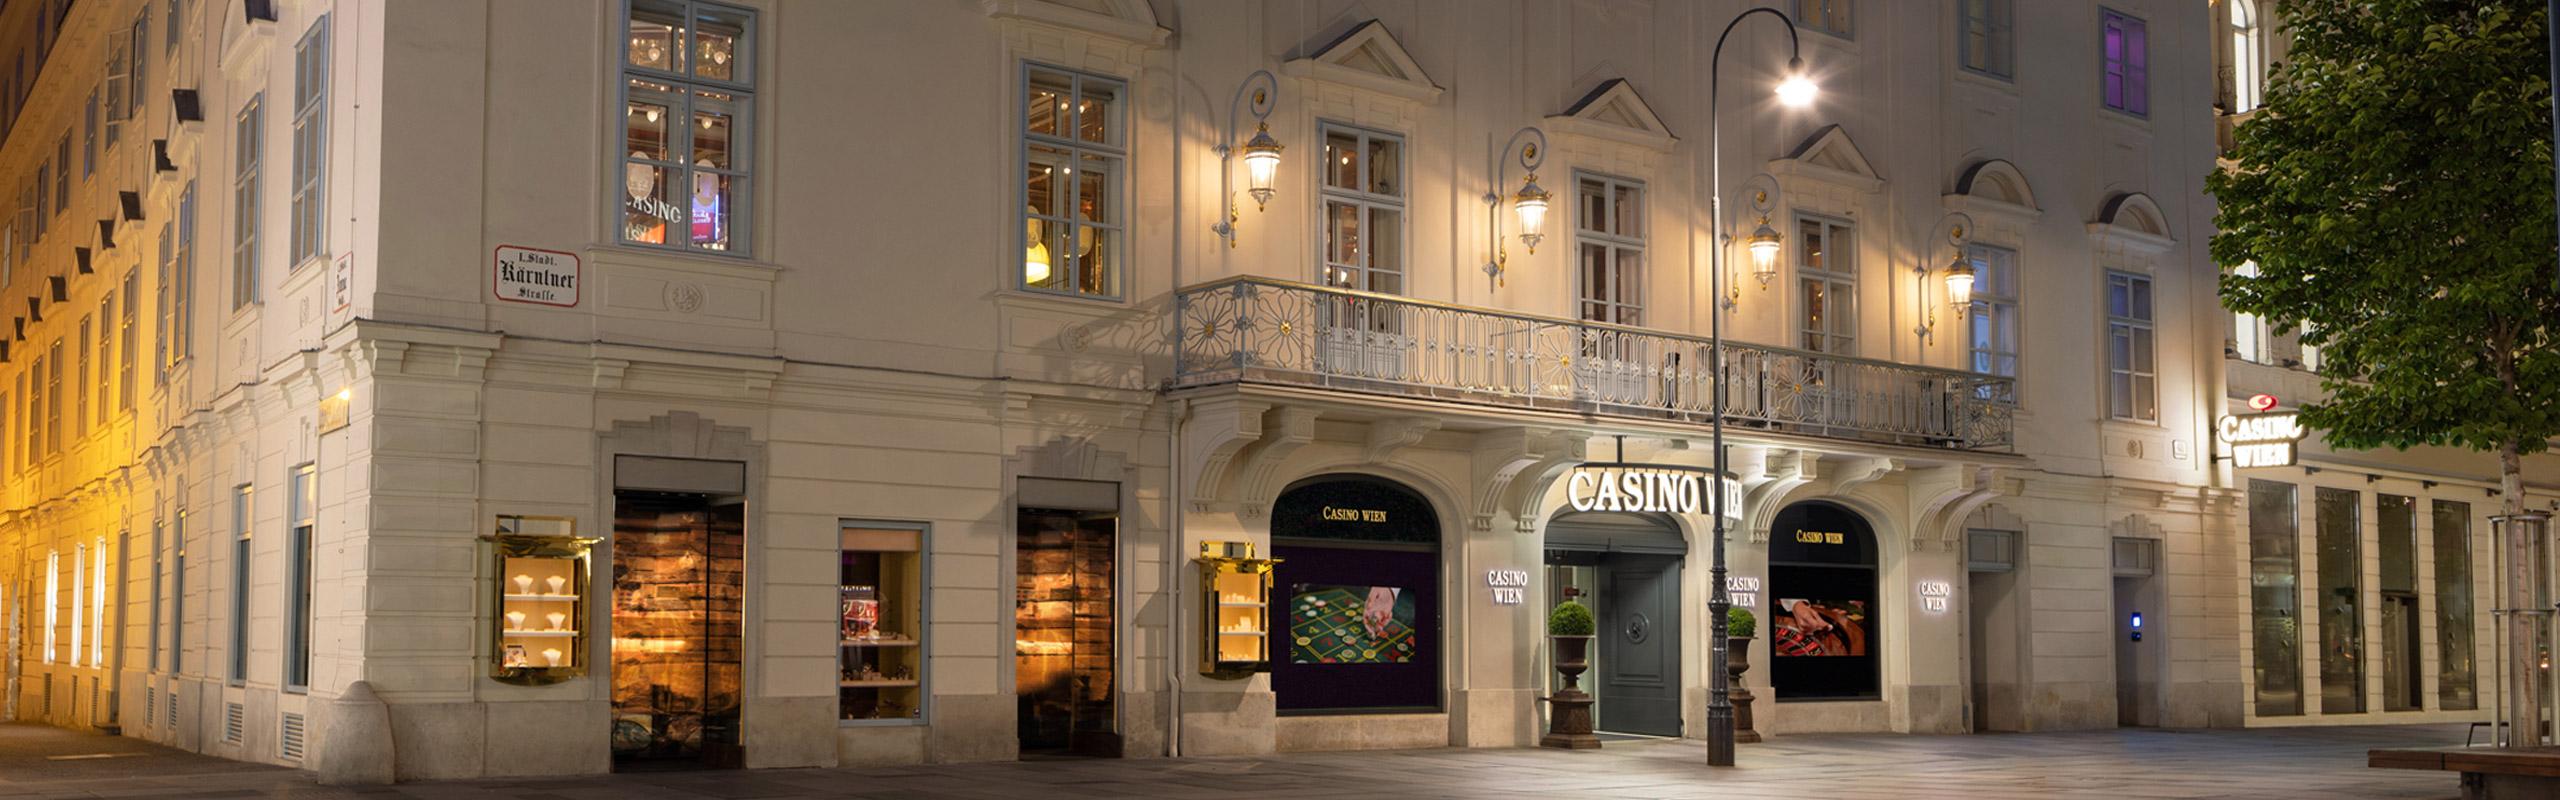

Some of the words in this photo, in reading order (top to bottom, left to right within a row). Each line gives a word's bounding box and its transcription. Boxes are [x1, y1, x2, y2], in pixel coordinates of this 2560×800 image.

[500, 259, 575, 289] Kärntner
[2220, 414, 2303, 442] CASINO
[2233, 442, 2290, 468] WIEN
[1567, 471, 1698, 514] CASINO
[1322, 505, 1359, 521] CASINO
[1362, 509, 1387, 522] WIEN
[1795, 528, 1824, 544] CASINO
[1488, 570, 1528, 586] CASINO
[1726, 577, 1760, 592] CASINO
[1493, 587, 1523, 604] WIEN
[1921, 582, 1950, 596] CASINO
[1731, 592, 1756, 607] WIEN
[1925, 597, 1947, 610] WIEN
